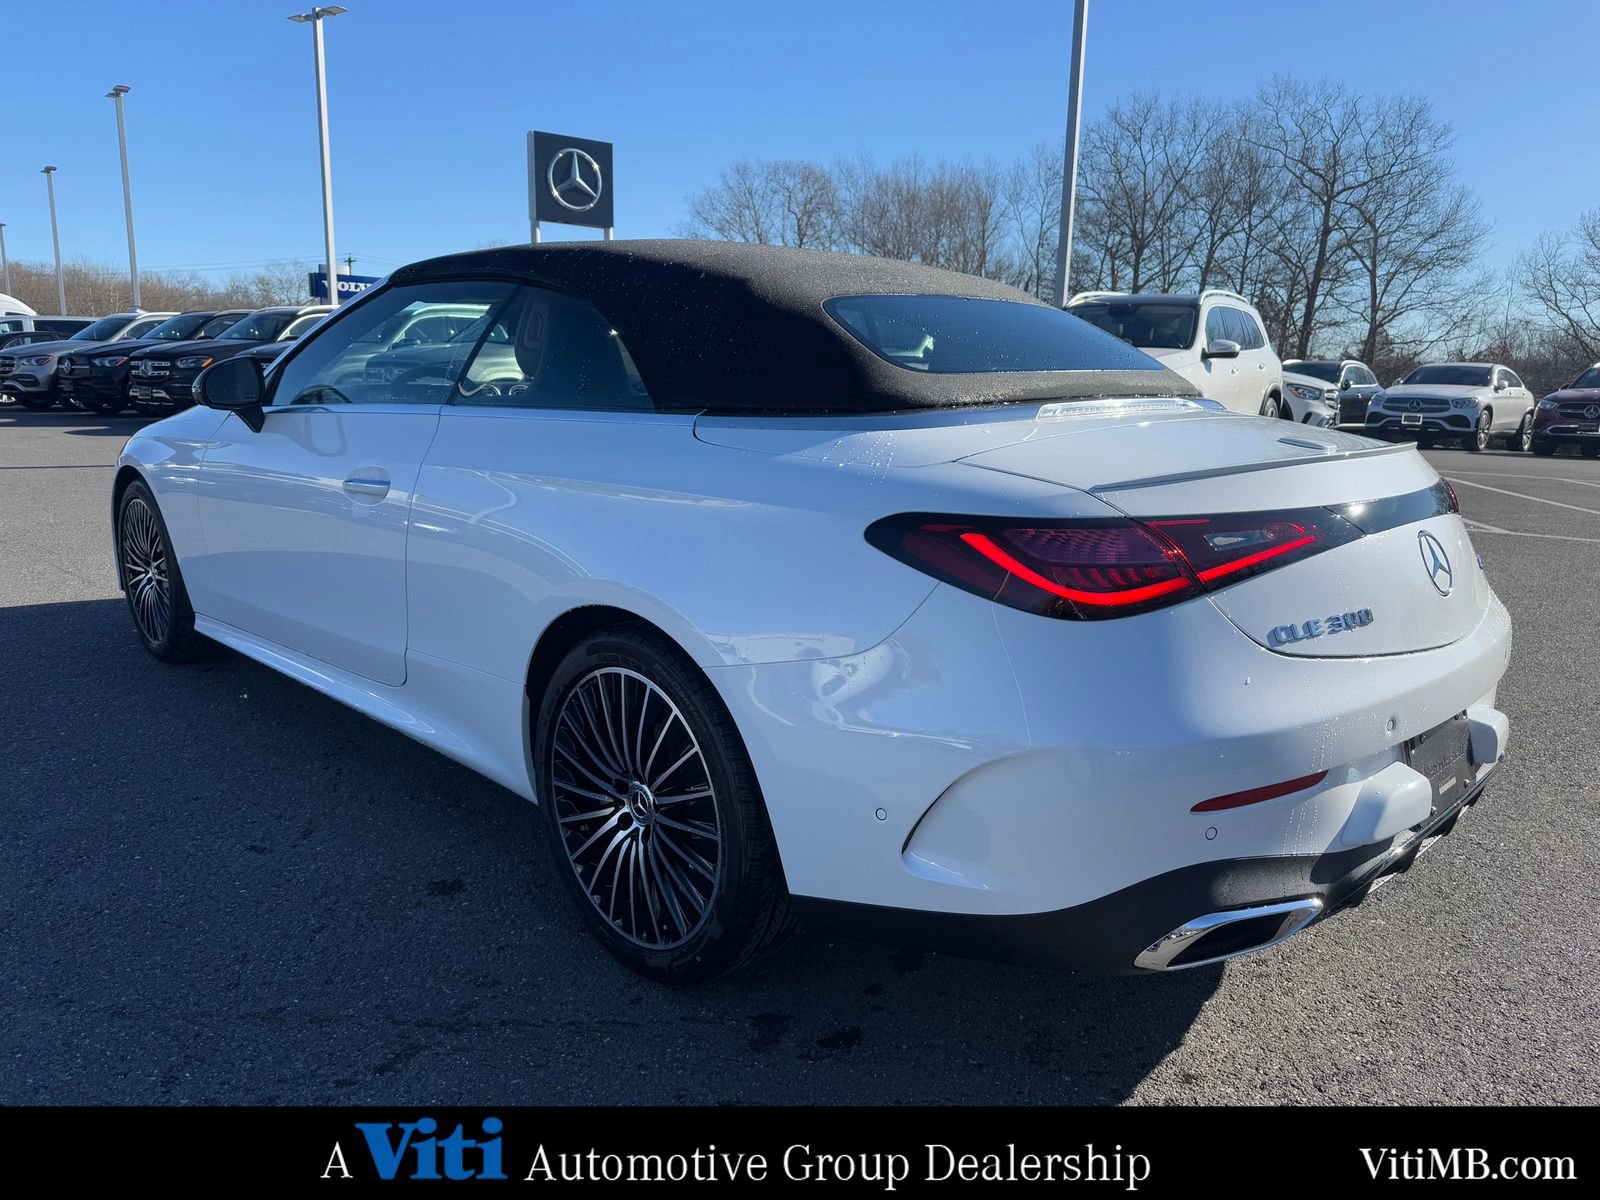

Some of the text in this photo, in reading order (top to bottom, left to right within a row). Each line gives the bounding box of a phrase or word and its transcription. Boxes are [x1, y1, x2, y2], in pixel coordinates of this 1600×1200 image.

[321, 280, 373, 292] OLV
[1270, 608, 1374, 645] CLE 300
